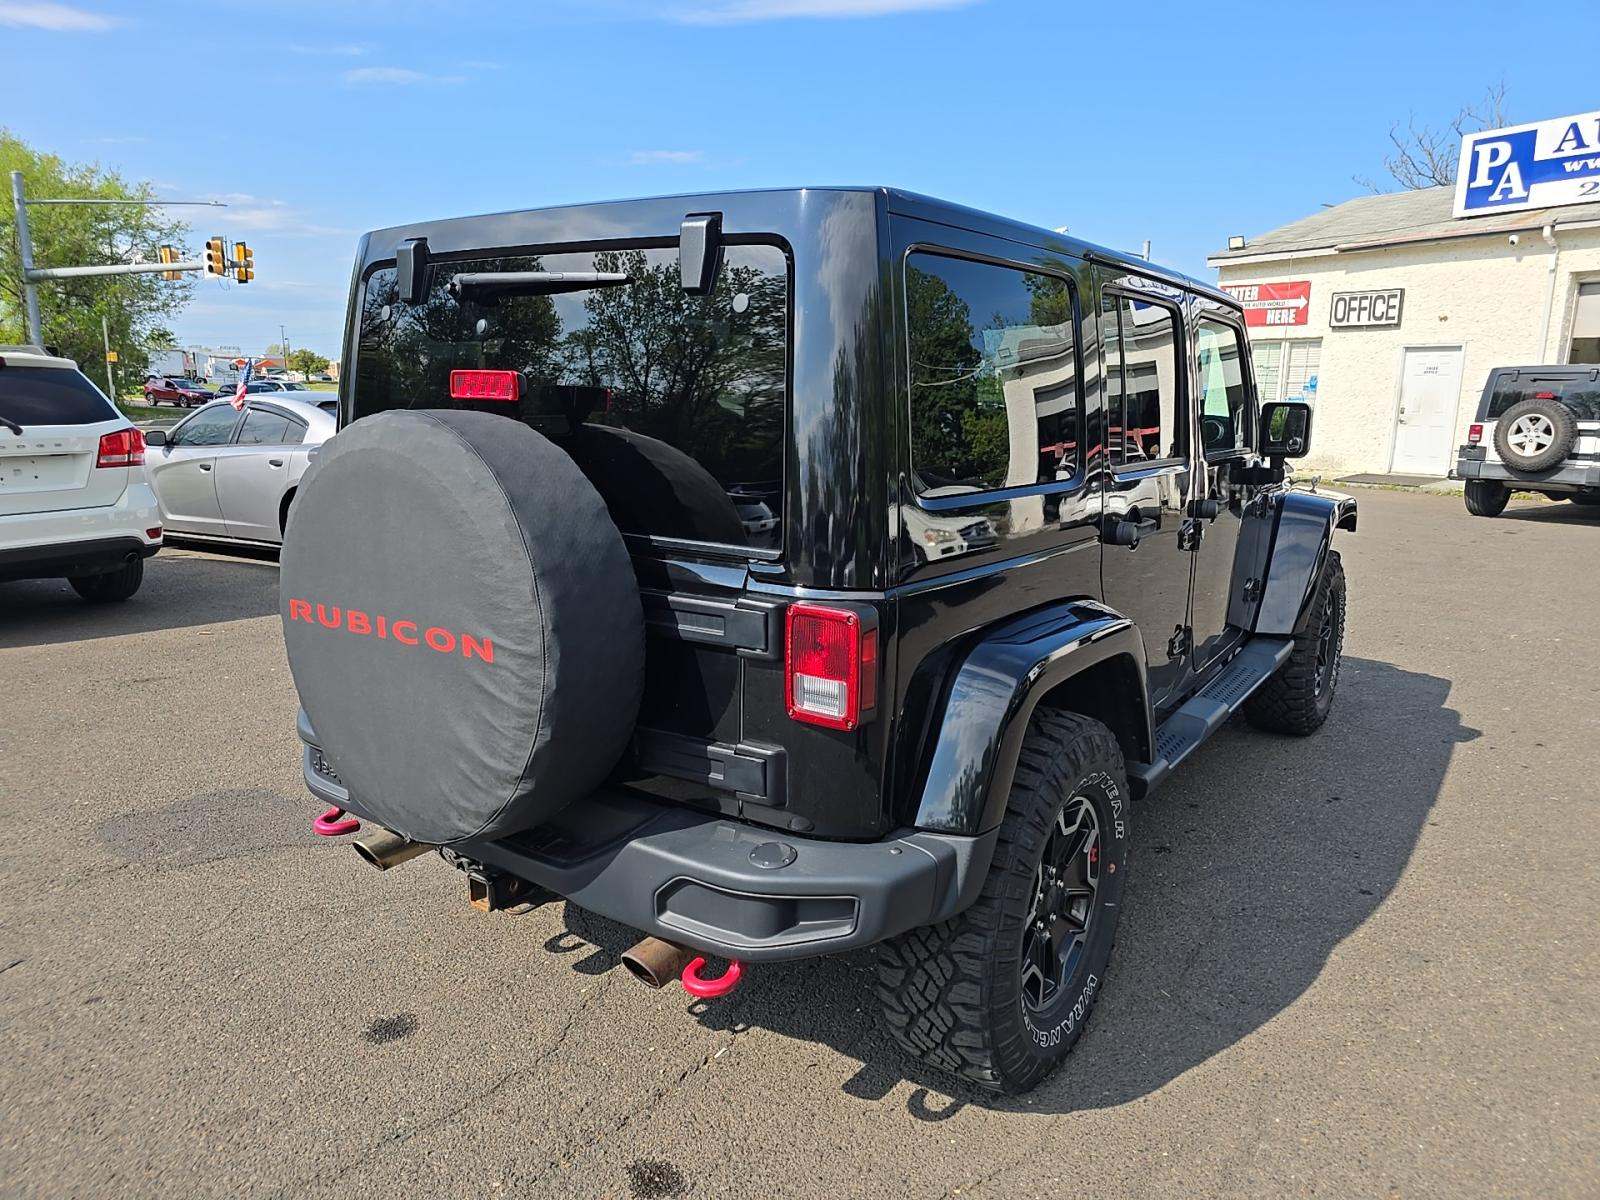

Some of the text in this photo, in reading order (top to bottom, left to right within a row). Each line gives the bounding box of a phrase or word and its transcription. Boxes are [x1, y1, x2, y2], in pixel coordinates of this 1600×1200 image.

[1266, 308, 1297, 324] HERE
[1334, 294, 1398, 323] OFFICE
[289, 599, 495, 664] RUBICON
